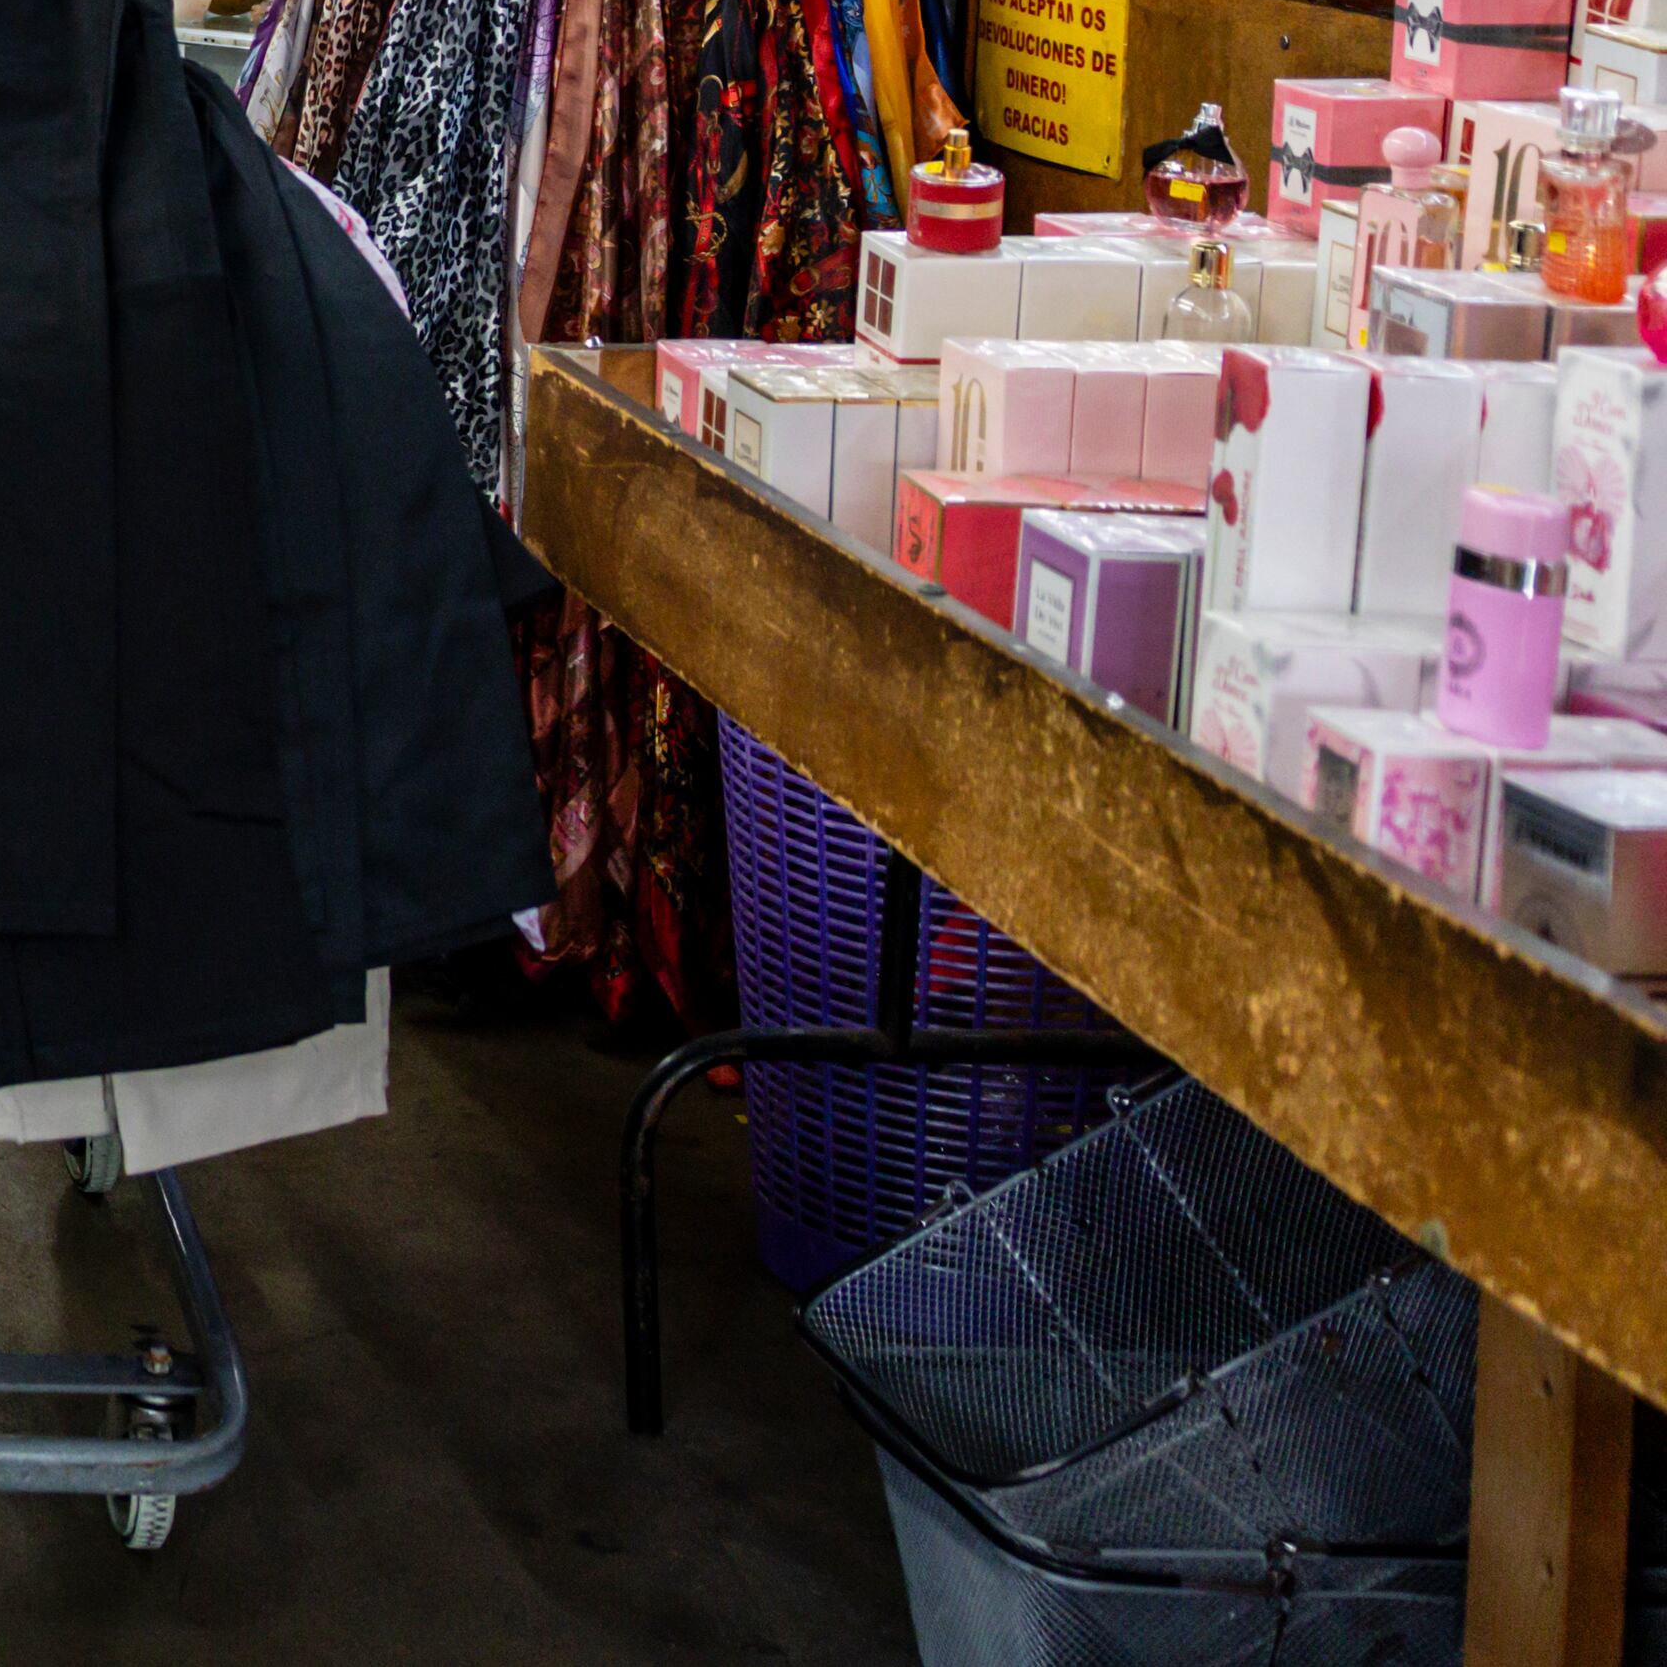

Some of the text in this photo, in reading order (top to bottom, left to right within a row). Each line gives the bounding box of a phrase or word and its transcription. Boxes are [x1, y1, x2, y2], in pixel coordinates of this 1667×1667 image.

[978, 17, 1118, 78] DEVOLUCIONES DE
[1005, 66, 1067, 106] DINERO!
[1002, 105, 1070, 148] GRACIAS
